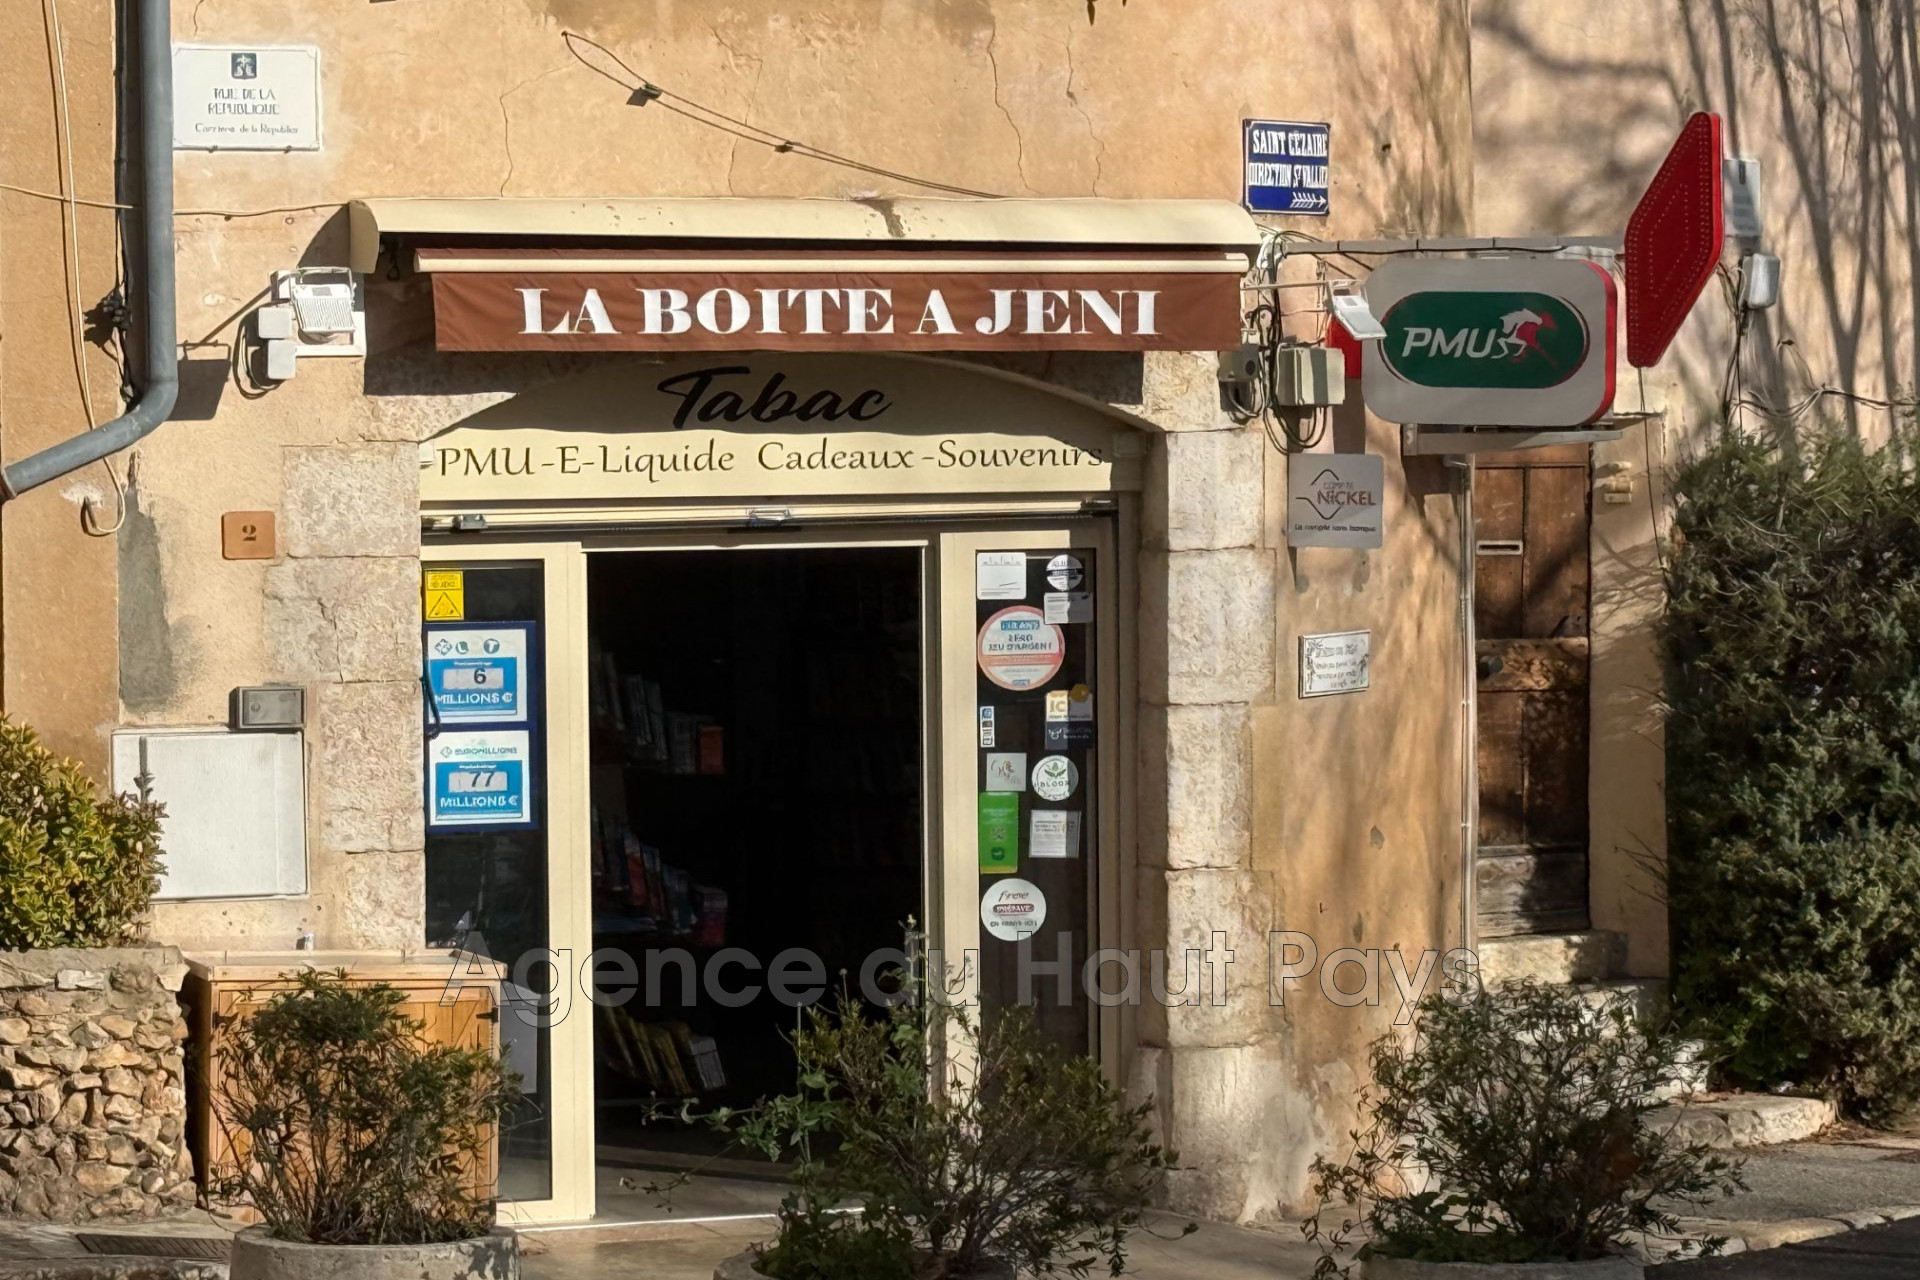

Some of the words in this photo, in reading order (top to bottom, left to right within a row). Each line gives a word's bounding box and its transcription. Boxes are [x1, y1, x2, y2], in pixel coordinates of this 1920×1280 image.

[213, 87, 238, 100] RUE
[242, 88, 256, 100] DE
[259, 88, 276, 100] LA
[1252, 129, 1286, 156] SAINT
[1247, 162, 1293, 188] DIRECTION
[514, 287, 622, 335] LA
[635, 286, 895, 335] BOITE
[909, 288, 963, 335] A
[975, 288, 1163, 335] JENI
[1401, 326, 1498, 360] PMU
[656, 365, 894, 430] Tabac
[241, 524, 257, 542] 2
[473, 667, 487, 685] 6
[435, 692, 500, 705] MILLIONS
[469, 770, 497, 788] 77
[440, 795, 506, 808] MILLIONS
